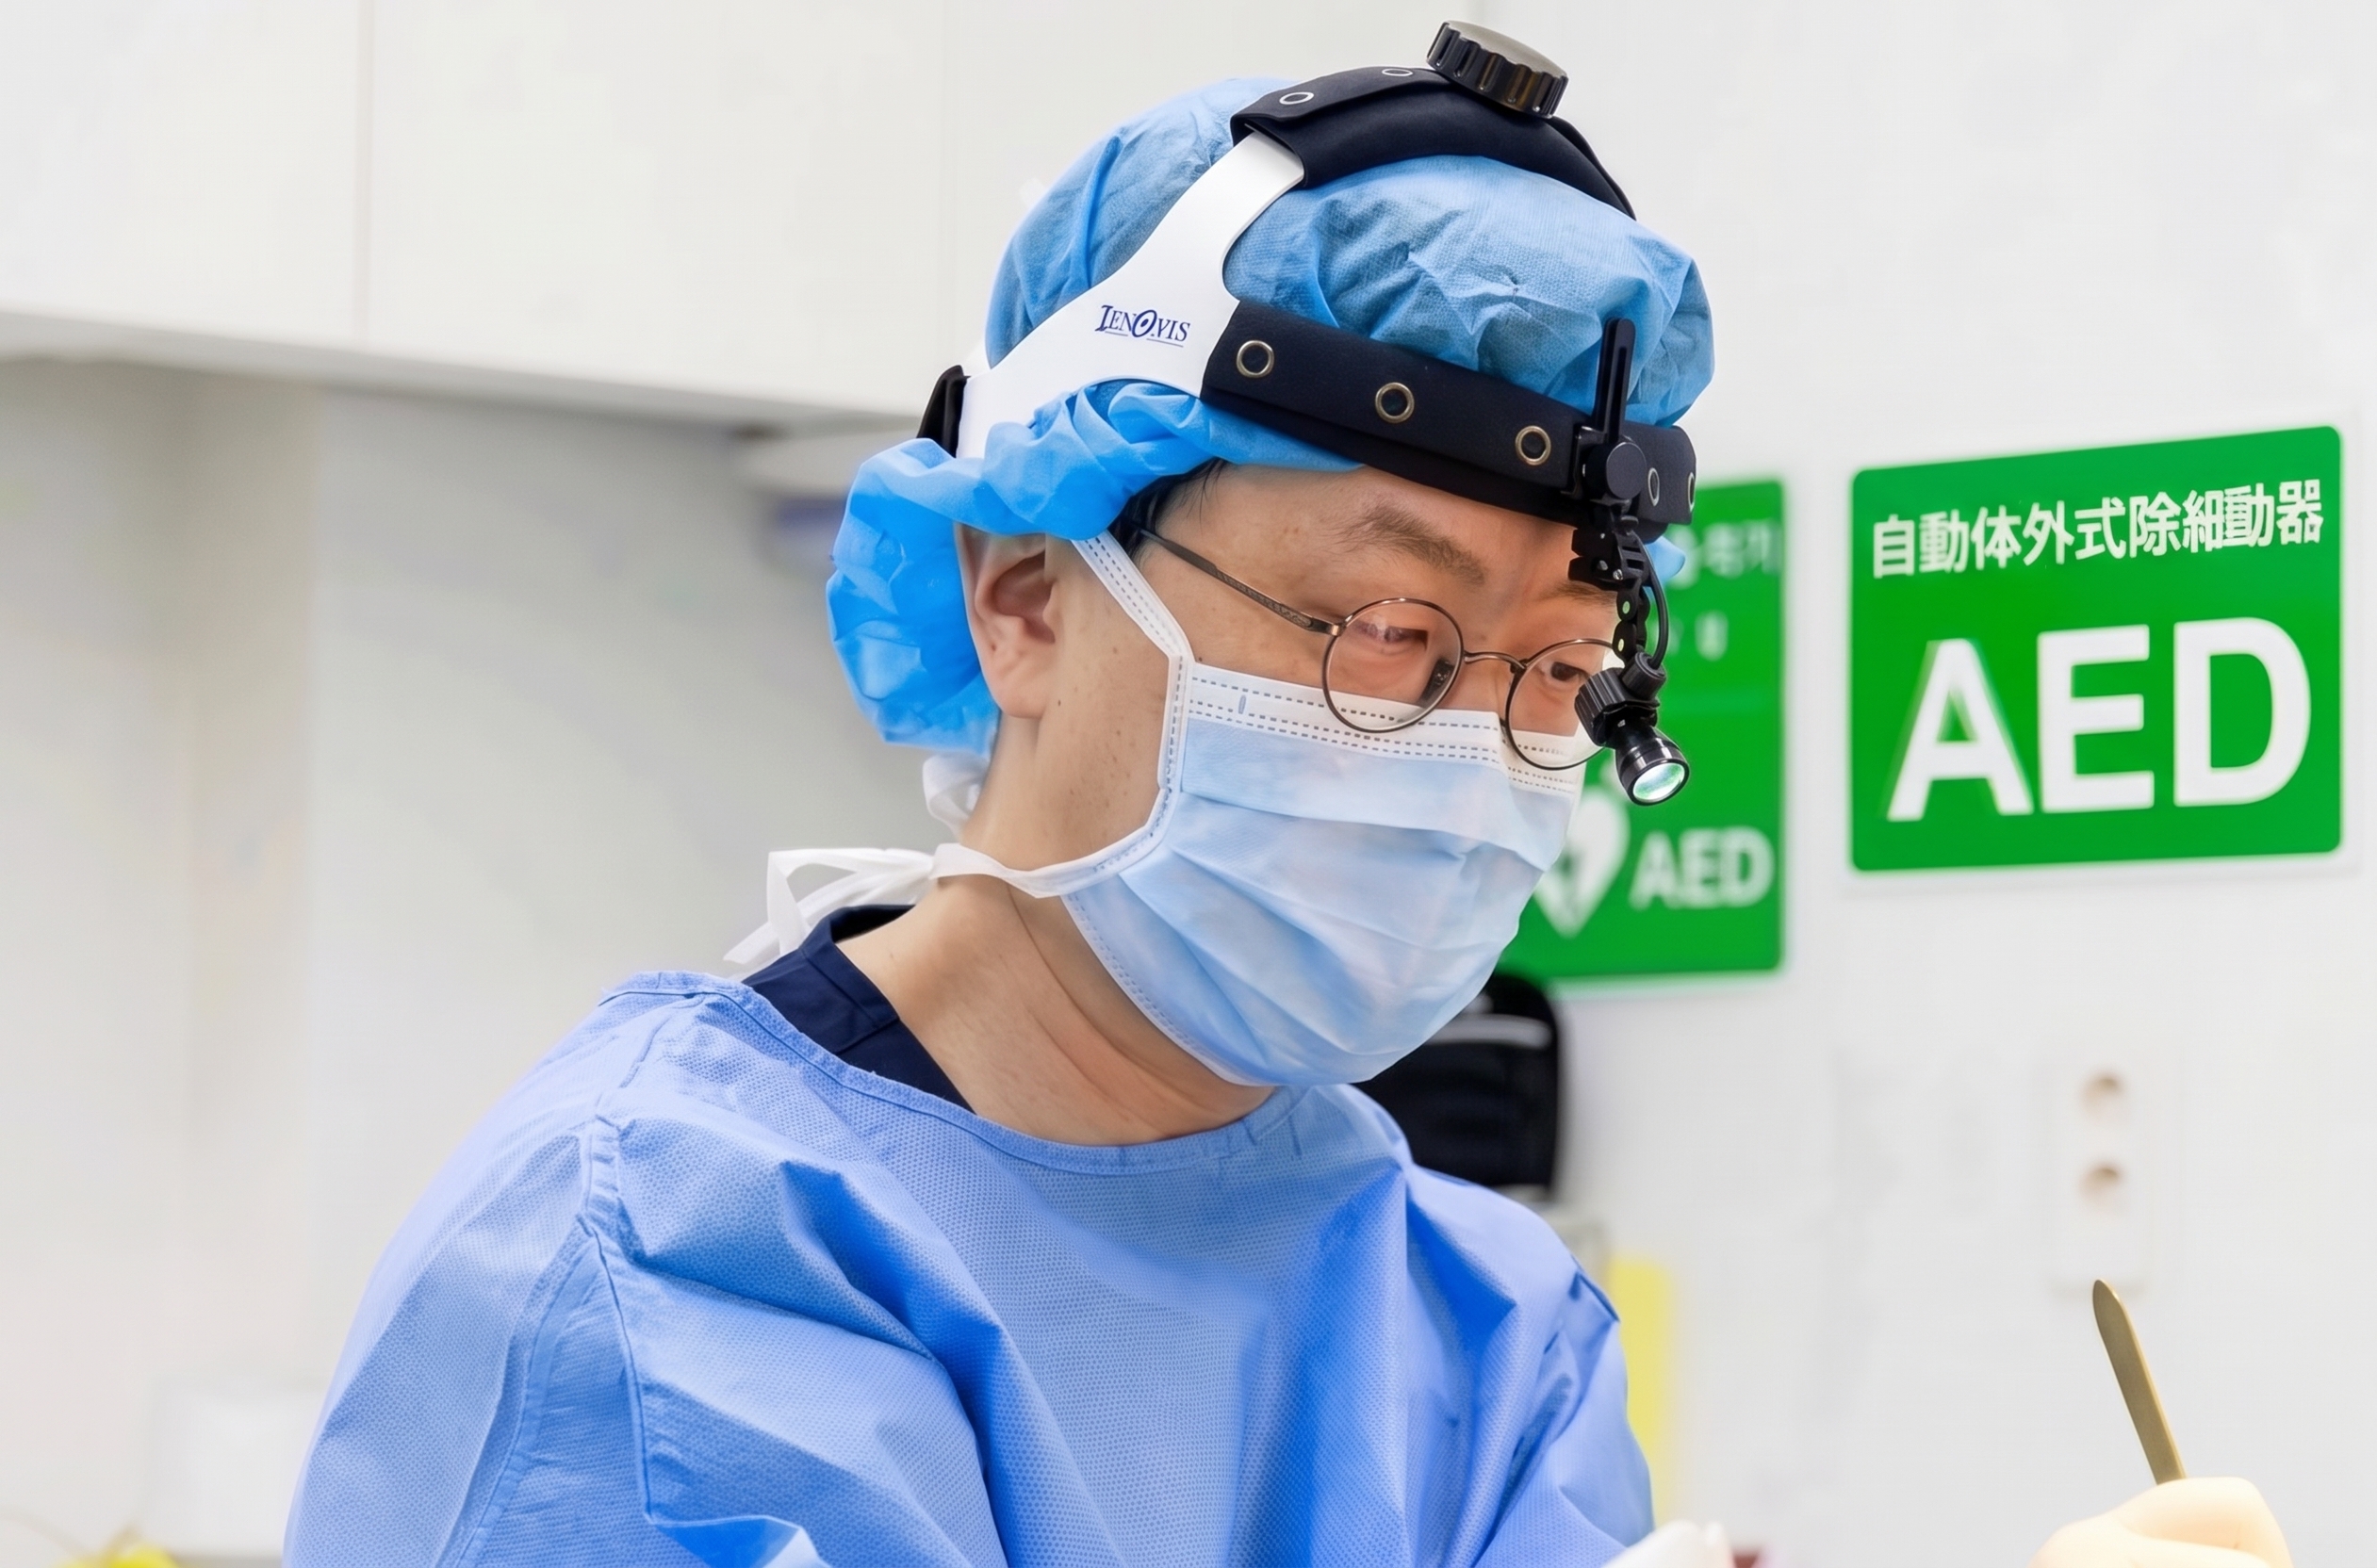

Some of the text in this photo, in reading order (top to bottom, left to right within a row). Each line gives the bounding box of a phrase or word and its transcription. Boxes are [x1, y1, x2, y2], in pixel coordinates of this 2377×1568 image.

[1872, 478, 2324, 580] 自動体外式除細動器
[1884, 616, 2312, 823] AED
[1630, 826, 1776, 911] AED
